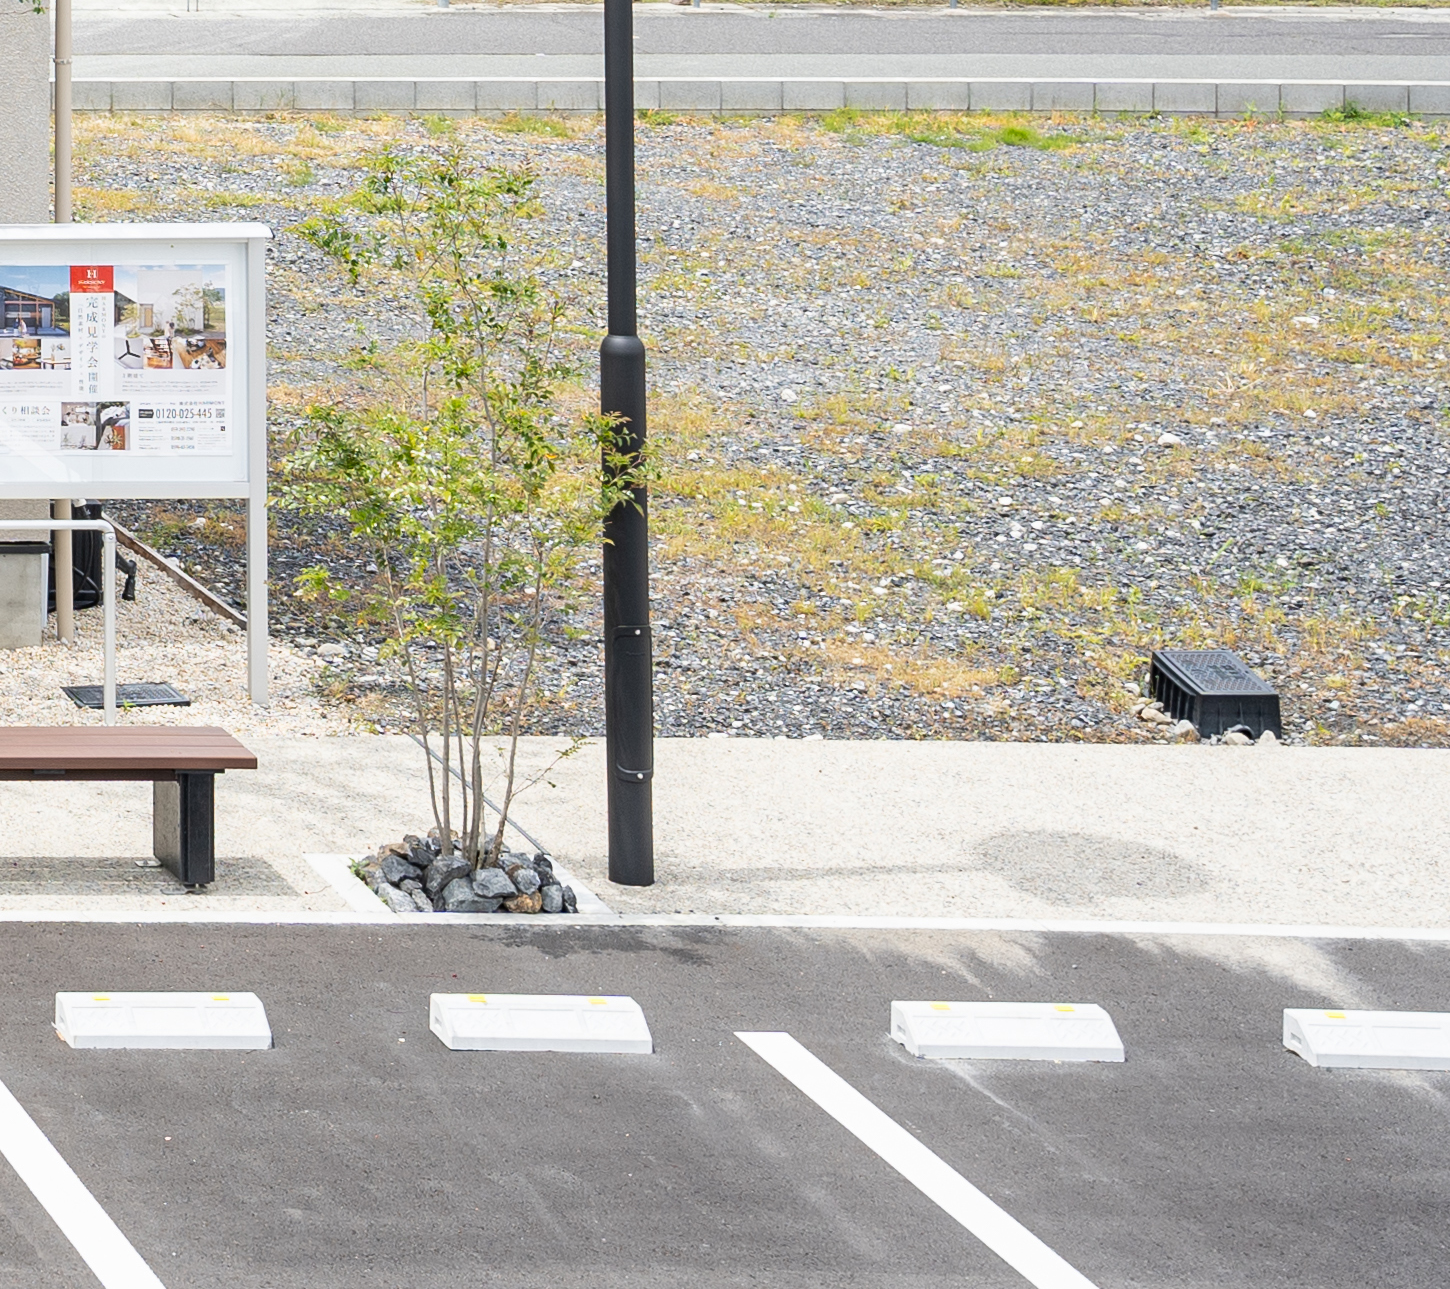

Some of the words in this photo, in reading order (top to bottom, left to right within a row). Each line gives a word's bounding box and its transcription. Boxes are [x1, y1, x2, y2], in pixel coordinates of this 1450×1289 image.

[86, 296, 99, 394] 完成見学会開催
[155, 408, 212, 419] 0120-025-445
